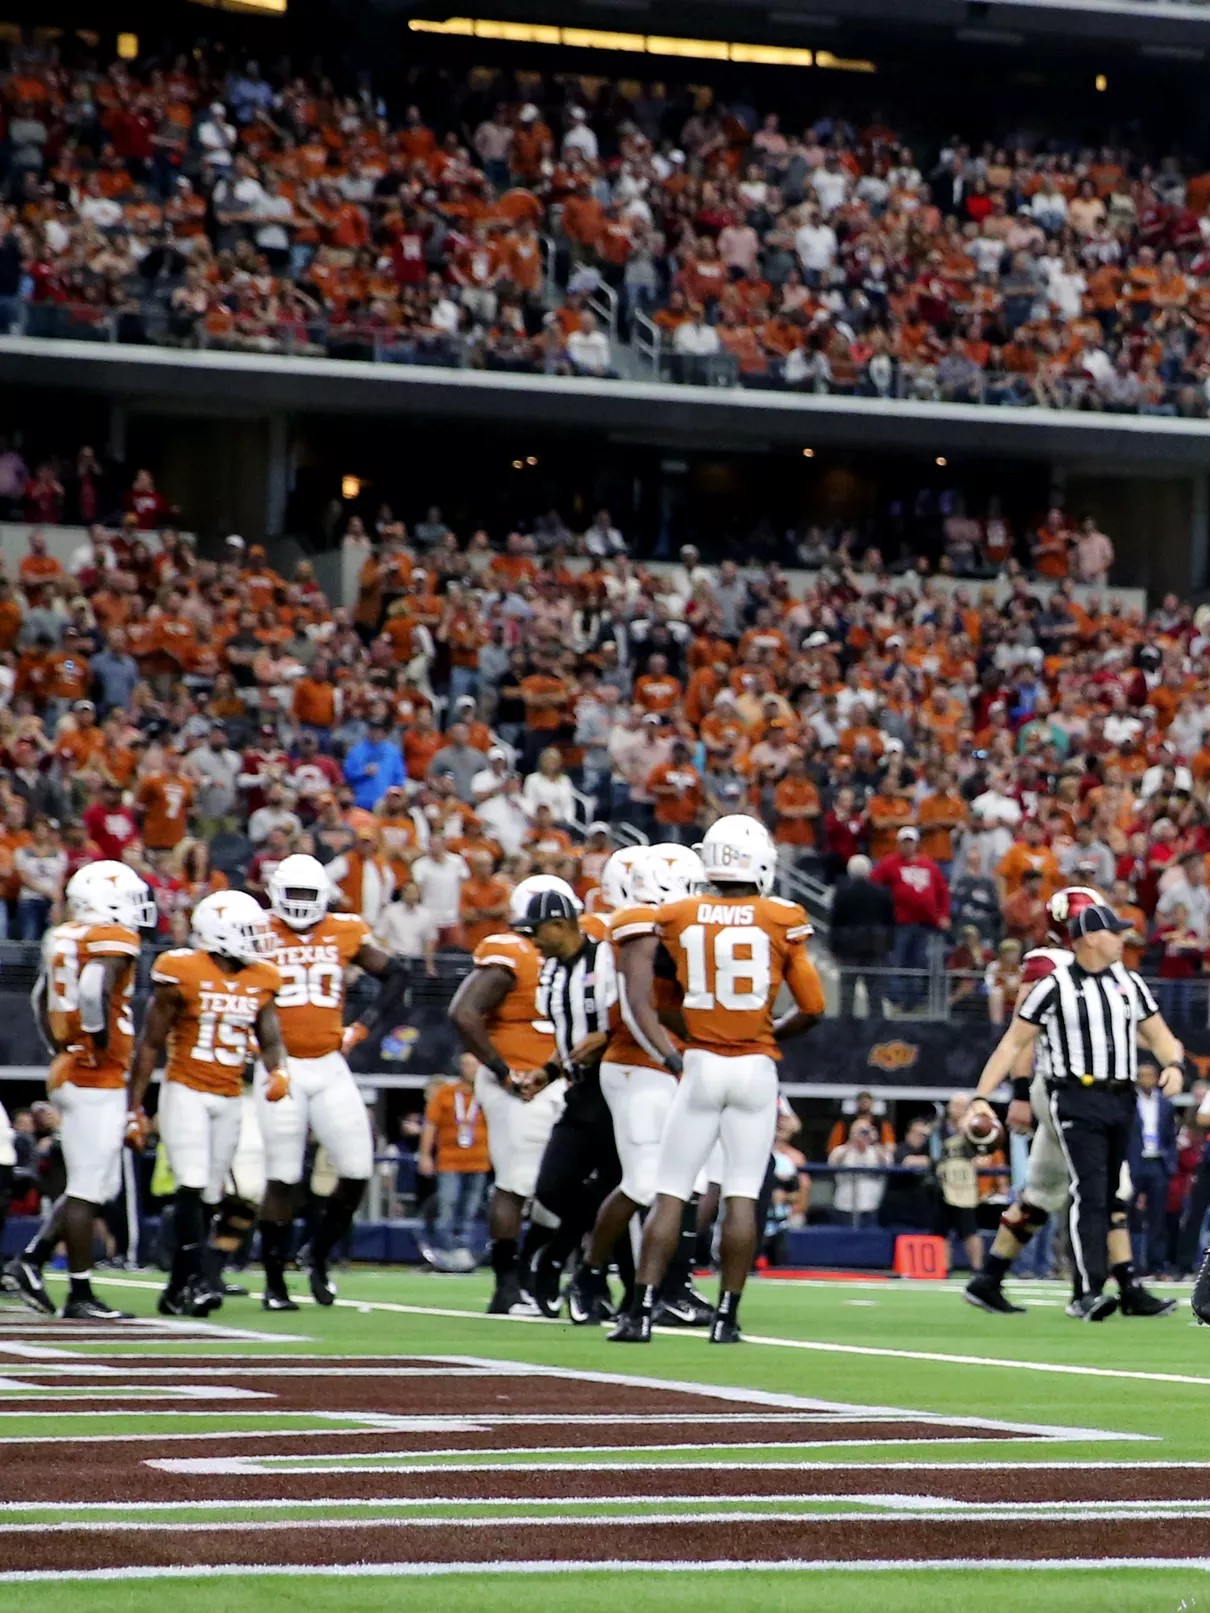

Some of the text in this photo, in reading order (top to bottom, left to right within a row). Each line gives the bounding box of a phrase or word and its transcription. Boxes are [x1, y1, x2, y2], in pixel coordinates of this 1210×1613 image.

[697, 903, 755, 926] DAVIS
[275, 945, 339, 965] TEXAS
[679, 925, 771, 1011] 18
[198, 991, 260, 1013] TEXAS
[190, 1011, 259, 1067] 15
[906, 1243, 937, 1273] 10
